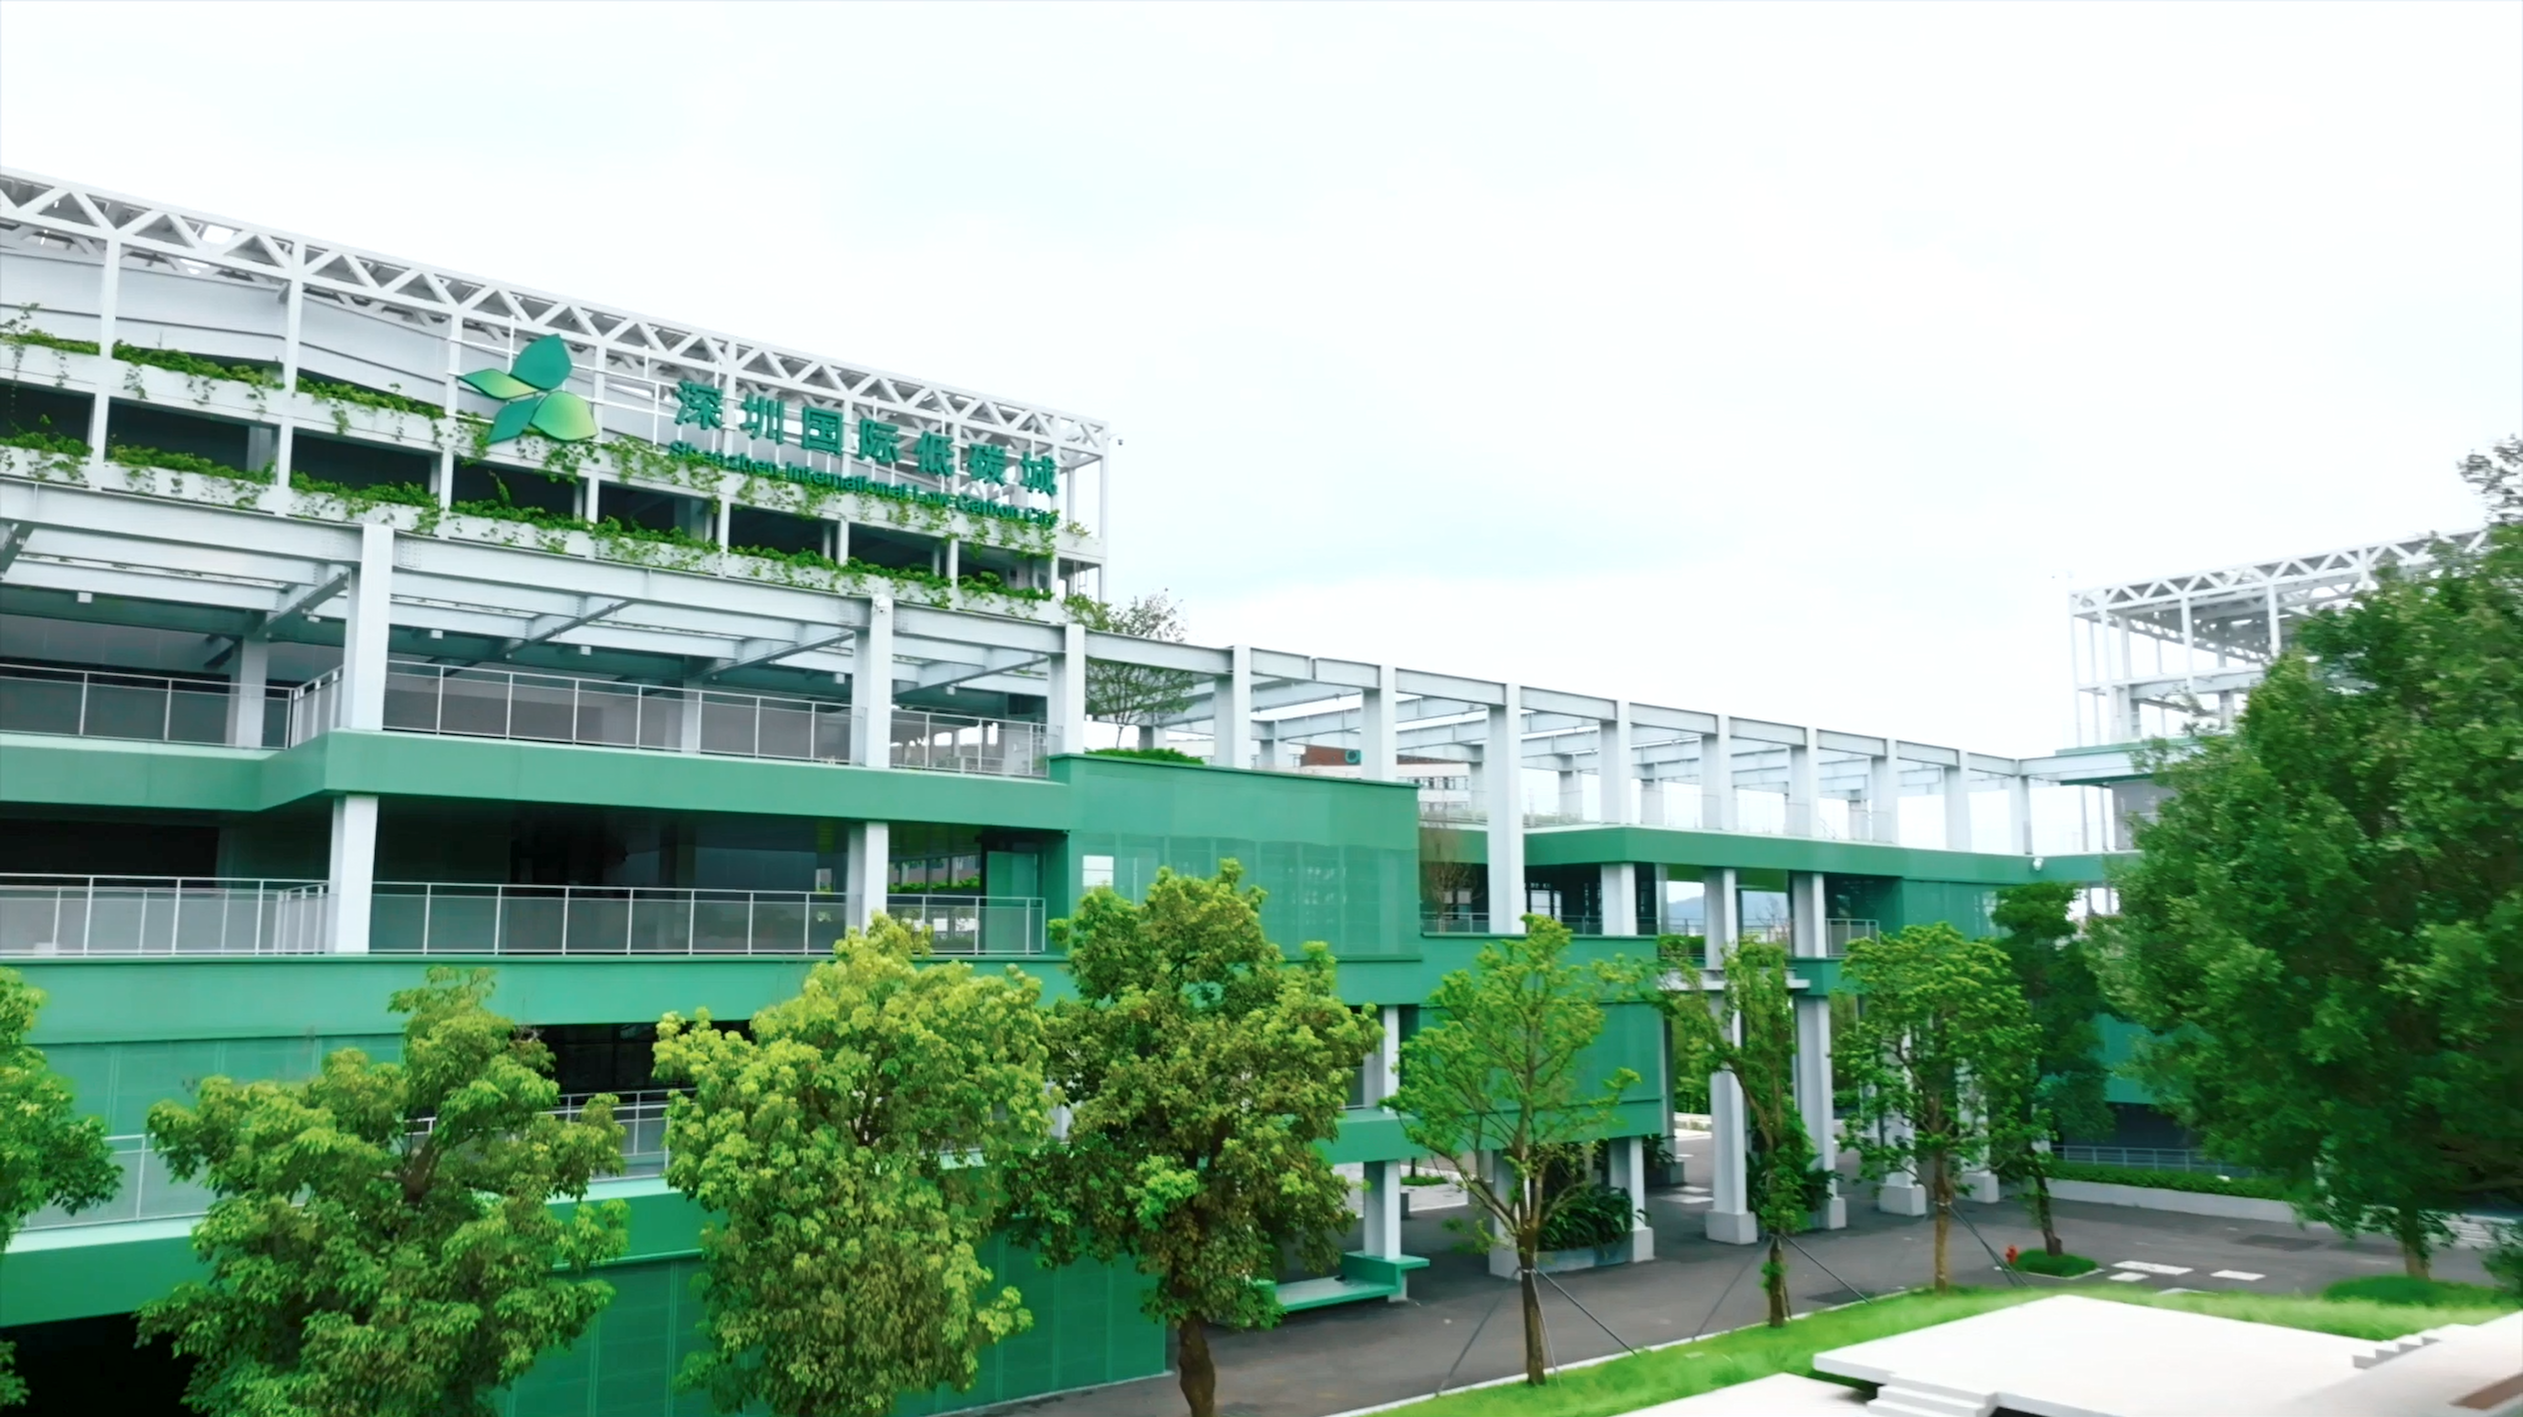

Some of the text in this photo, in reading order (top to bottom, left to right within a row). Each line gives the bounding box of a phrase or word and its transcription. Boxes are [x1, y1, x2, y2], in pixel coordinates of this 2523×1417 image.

[674, 379, 1057, 496] 深圳国际低碳城
[785, 461, 906, 500] International
[912, 485, 952, 507] Low
[956, 494, 1019, 519] Carbon
[1023, 507, 1058, 527] City
